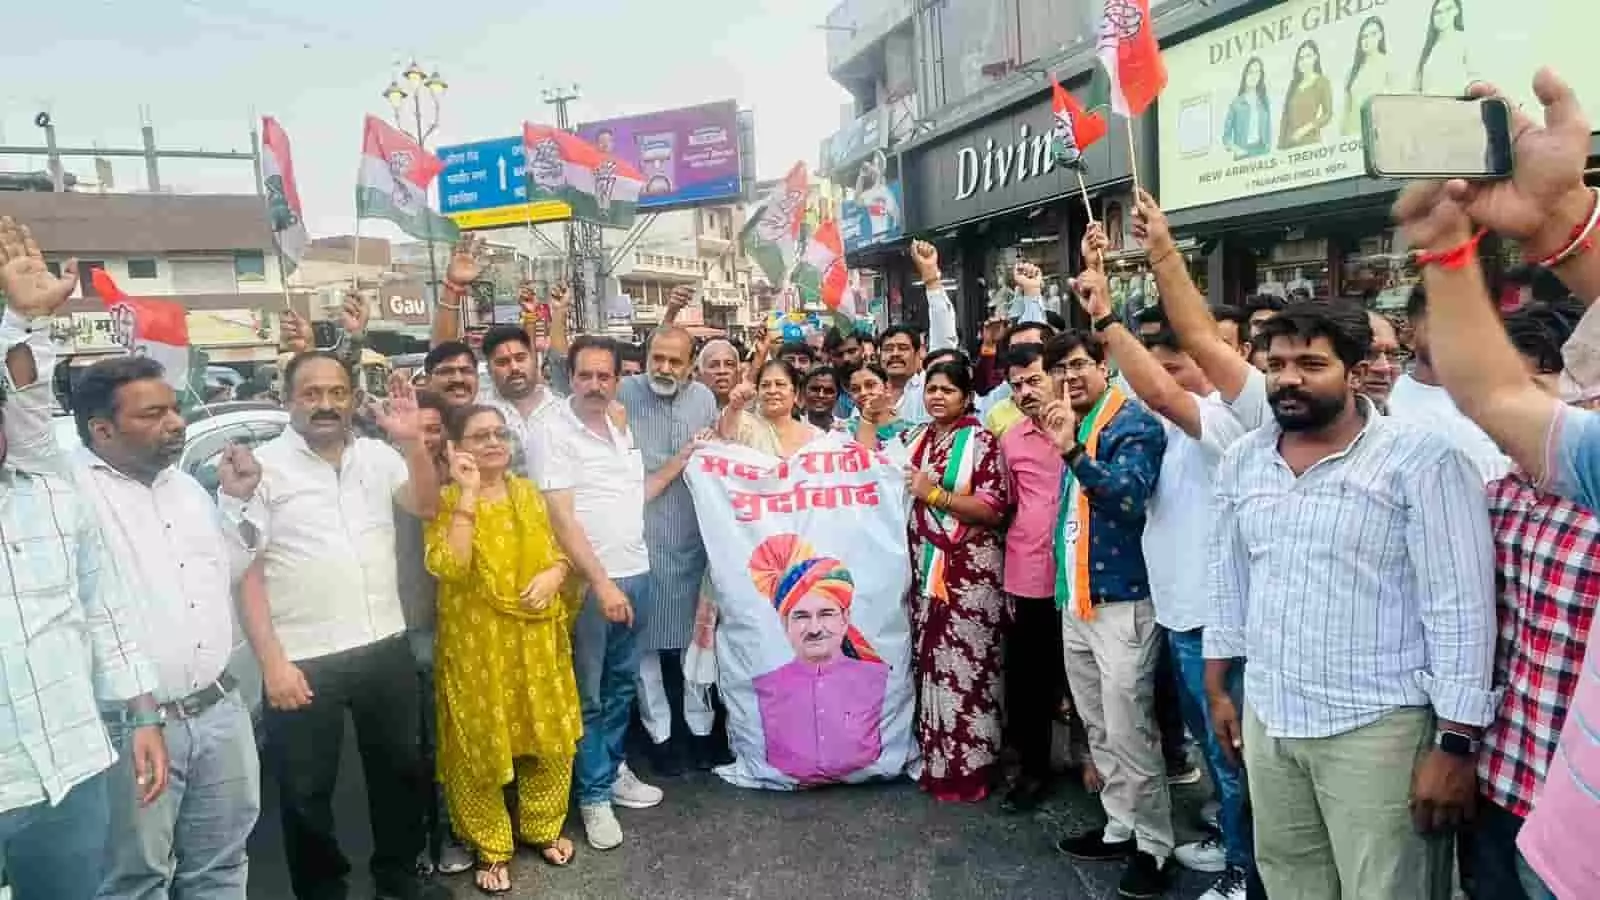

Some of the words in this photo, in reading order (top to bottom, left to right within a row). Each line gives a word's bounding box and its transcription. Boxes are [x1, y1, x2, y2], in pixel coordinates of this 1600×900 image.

[1209, 15, 1294, 65] DIVINE
[1302, 0, 1386, 31] GIRL
[954, 123, 1055, 201] Divin
[1199, 168, 1224, 185] NEW
[1225, 157, 1279, 177] ARRIVALS
[1288, 145, 1336, 164] TRENDY
[728, 480, 880, 522] मुर्दाबाद
